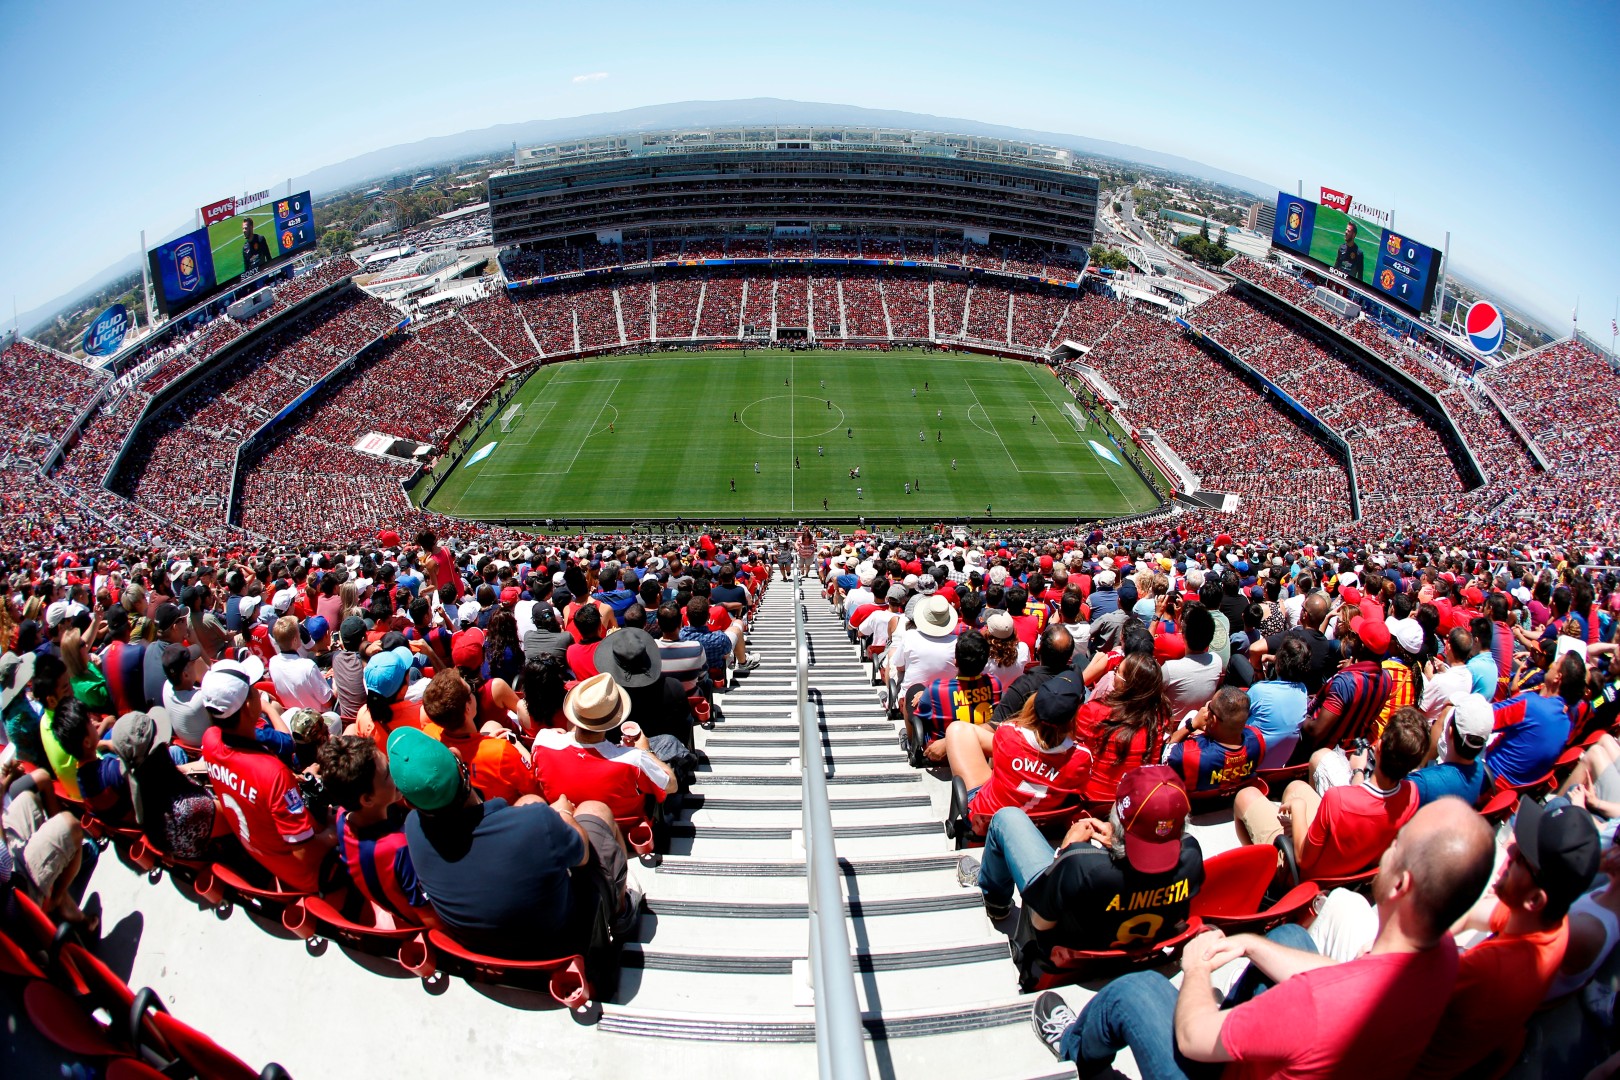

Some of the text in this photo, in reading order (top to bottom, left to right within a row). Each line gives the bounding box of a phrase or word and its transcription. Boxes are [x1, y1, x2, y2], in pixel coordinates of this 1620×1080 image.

[235, 189, 270, 208] STADIUM
[294, 201, 300, 211] 0
[1352, 201, 1389, 222] STADIUM
[298, 230, 304, 239] 1
[1407, 248, 1415, 259] 0
[240, 266, 261, 281] SONY
[1329, 266, 1349, 280] SONY
[1392, 261, 1410, 275] 42:39
[1401, 283, 1408, 294] 1
[92, 319, 127, 349] LIGHT
[96, 313, 123, 336] BUD
[952, 685, 992, 706] MESSI
[1011, 757, 1060, 782] OWEN
[1209, 760, 1254, 785] MESSI
[240, 779, 258, 804] LE
[1016, 780, 1049, 812] 7
[1127, 878, 1189, 911] INIESTA
